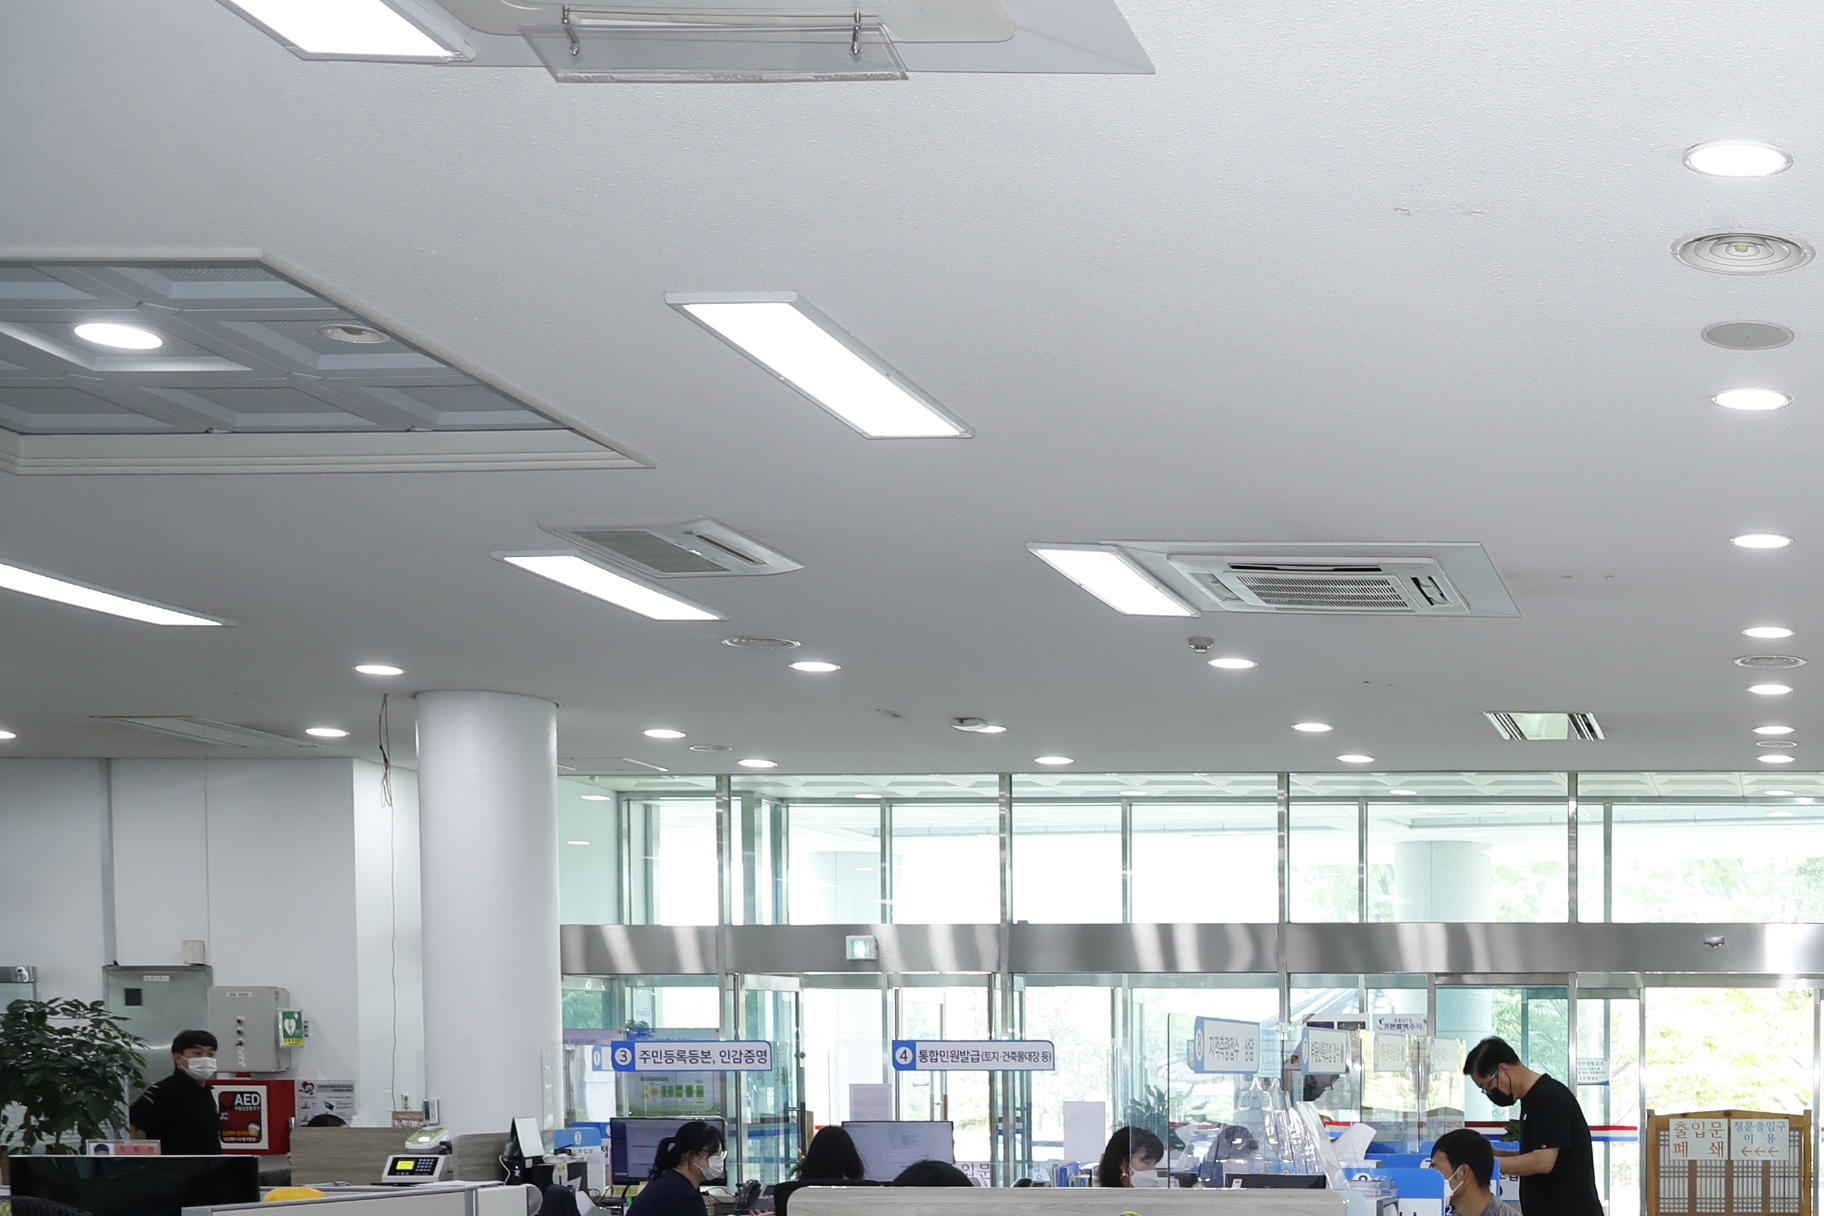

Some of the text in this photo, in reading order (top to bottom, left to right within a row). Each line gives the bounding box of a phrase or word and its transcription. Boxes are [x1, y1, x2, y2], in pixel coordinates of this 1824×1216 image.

[620, 1049, 768, 1065] 3 주민등록등본, 인감증명
[900, 1050, 908, 1062] 4
[234, 1094, 260, 1106] AED
[1673, 1121, 1725, 1139] 출입문
[1734, 1121, 1786, 1132] 정문출입구
